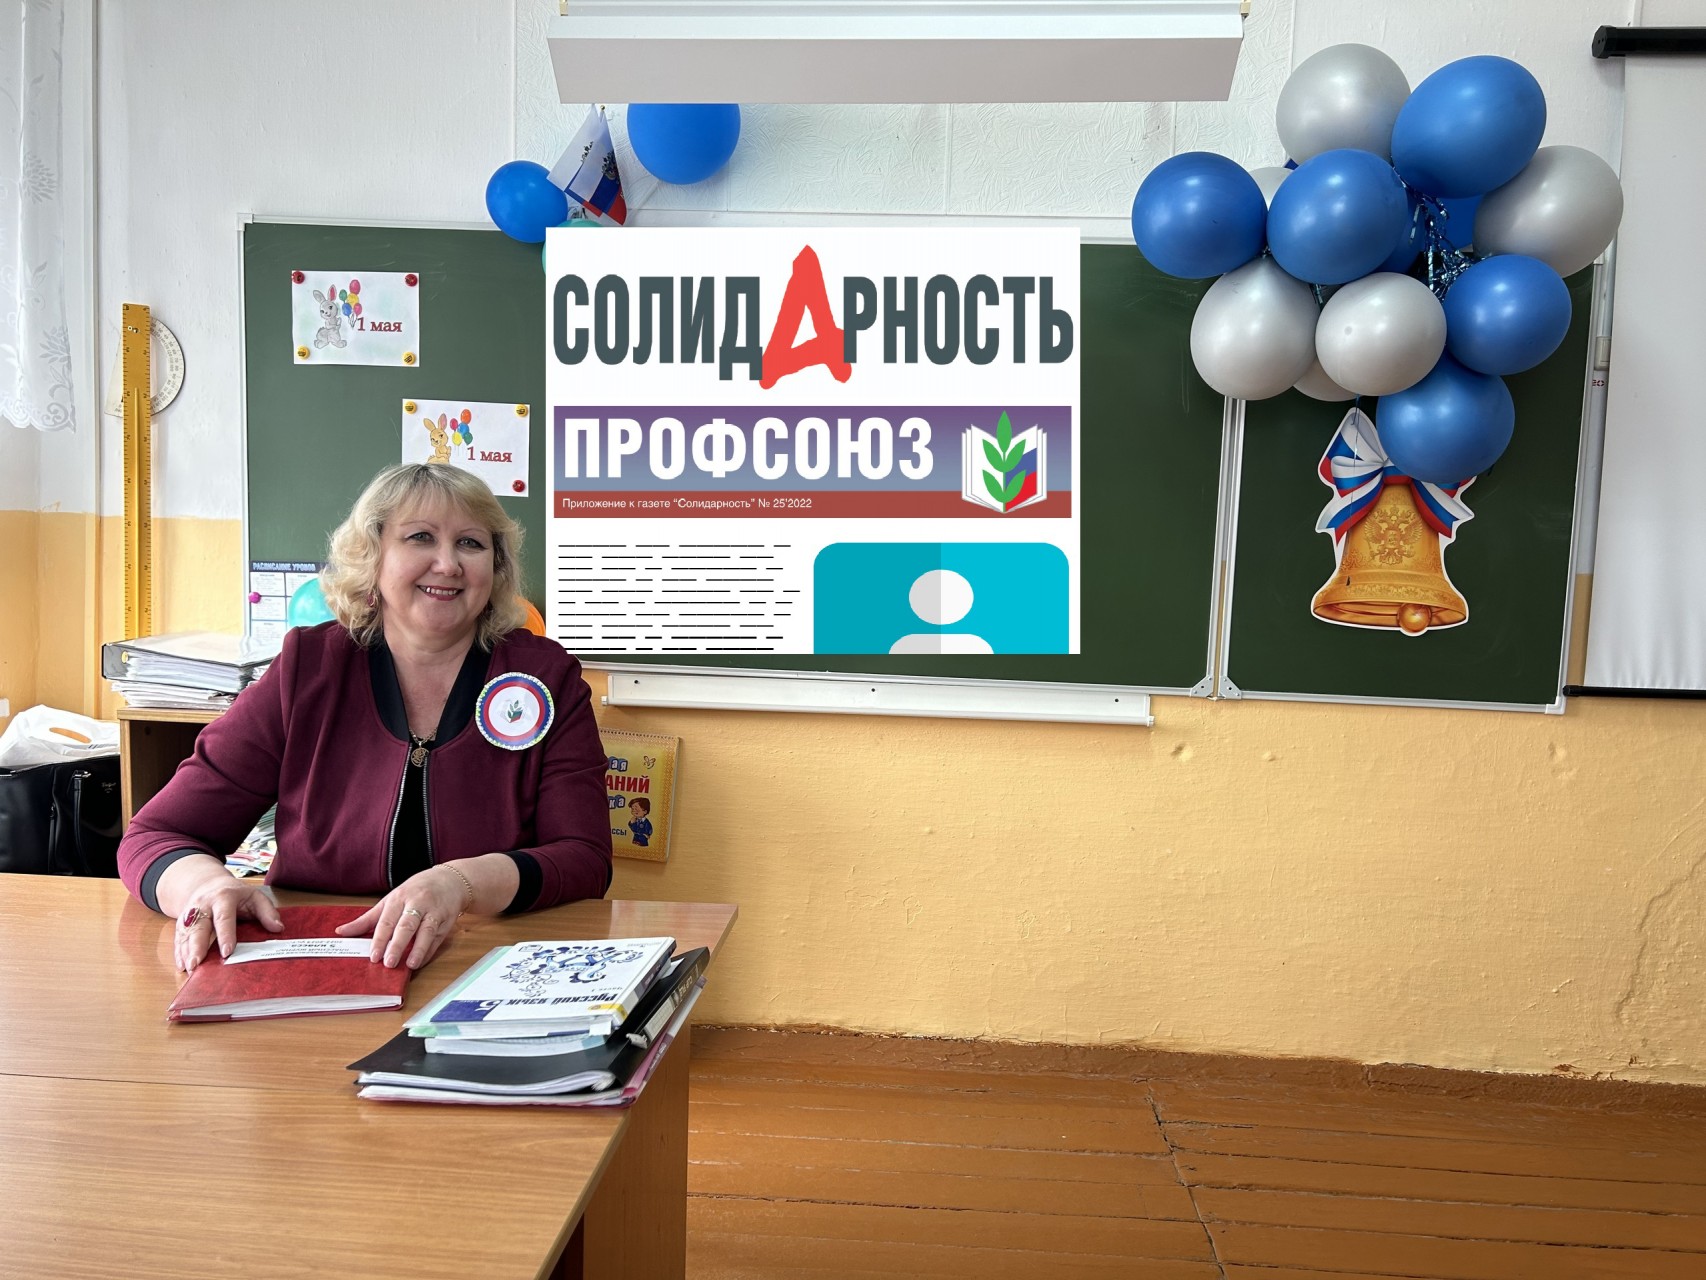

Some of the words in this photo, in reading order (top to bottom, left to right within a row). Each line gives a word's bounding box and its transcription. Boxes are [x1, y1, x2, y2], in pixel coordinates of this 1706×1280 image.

[357, 316, 366, 331] 1
[370, 319, 402, 333] мая
[553, 245, 1074, 389] СОЛИДАРНОСТЬ
[467, 446, 476, 461] 1
[480, 449, 513, 463] мая
[564, 417, 934, 480] ПРОФСОЮЗ
[562, 498, 627, 510] Приложение
[629, 500, 635, 508] к
[637, 500, 671, 508] газете
[758, 498, 771, 508] №
[606, 774, 650, 793] АНИЙ
[474, 1000, 501, 1011] 5
[551, 993, 618, 1006] Русский
